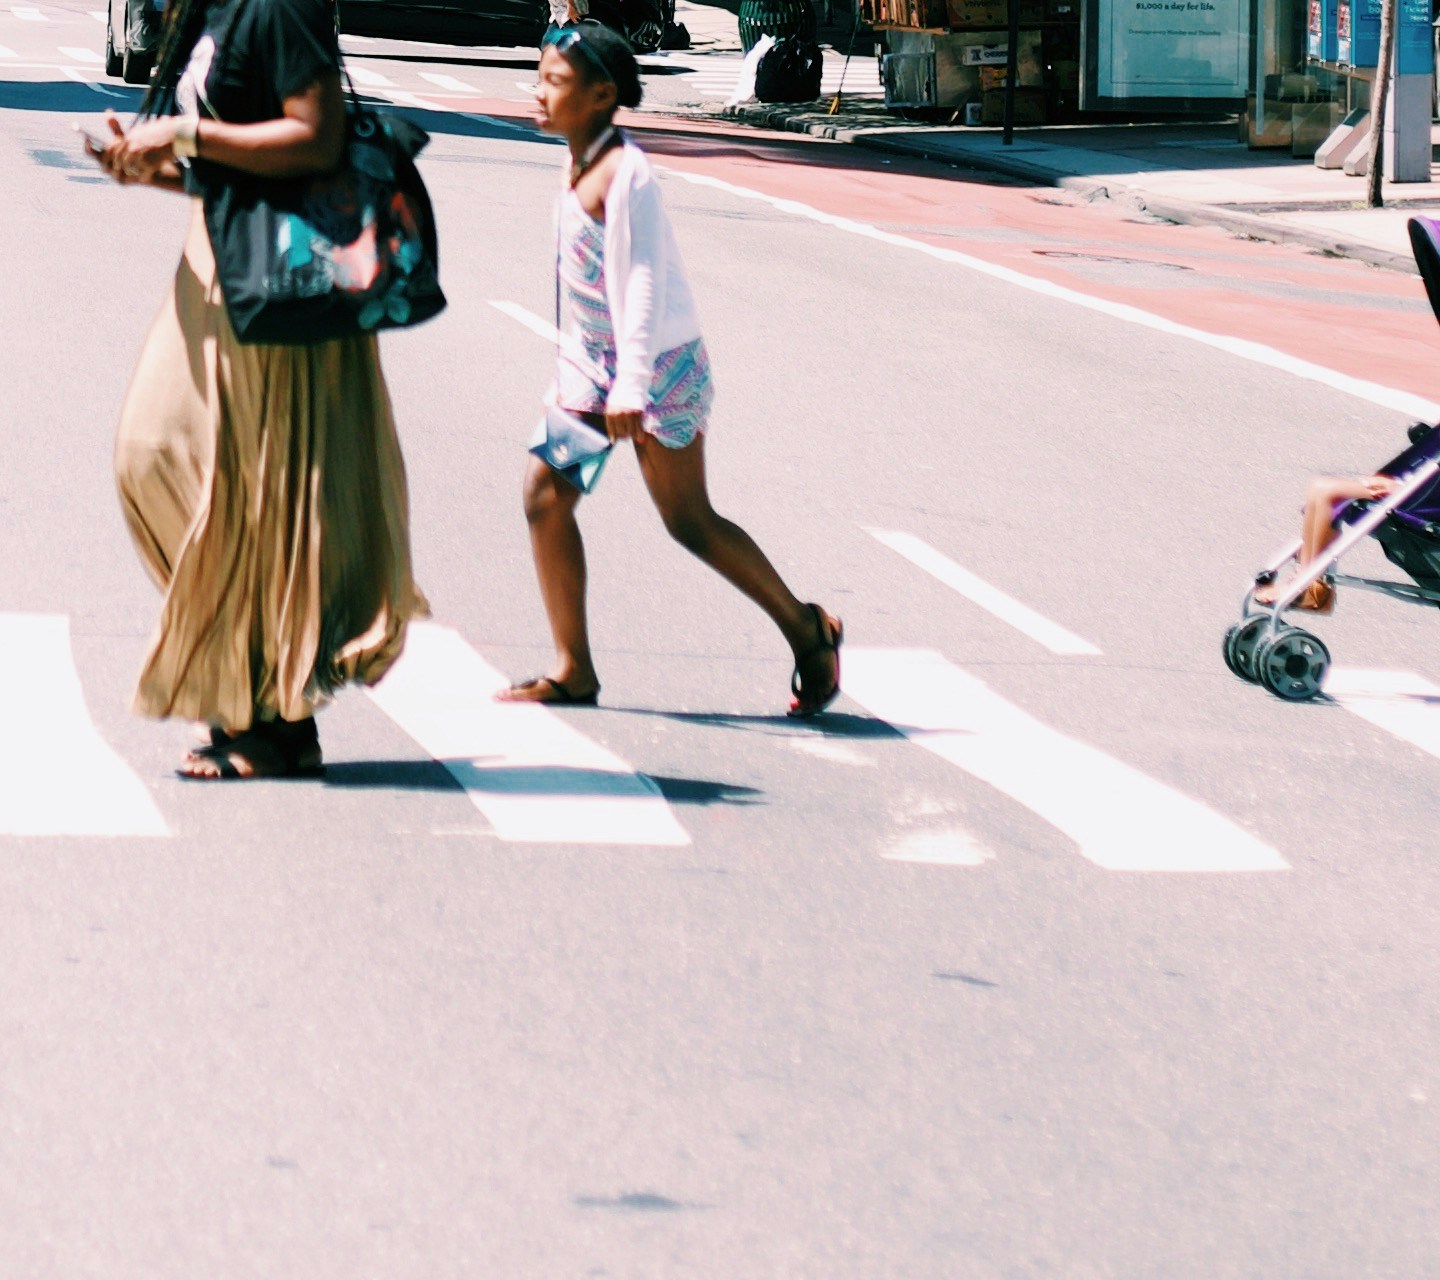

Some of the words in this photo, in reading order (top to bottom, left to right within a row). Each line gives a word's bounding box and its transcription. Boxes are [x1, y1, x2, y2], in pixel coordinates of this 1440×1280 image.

[1135, 2, 1163, 11] $1,000
[1170, 2, 1185, 12] day
[1186, 2, 1199, 11] for
[1200, 2, 1216, 11] life.
